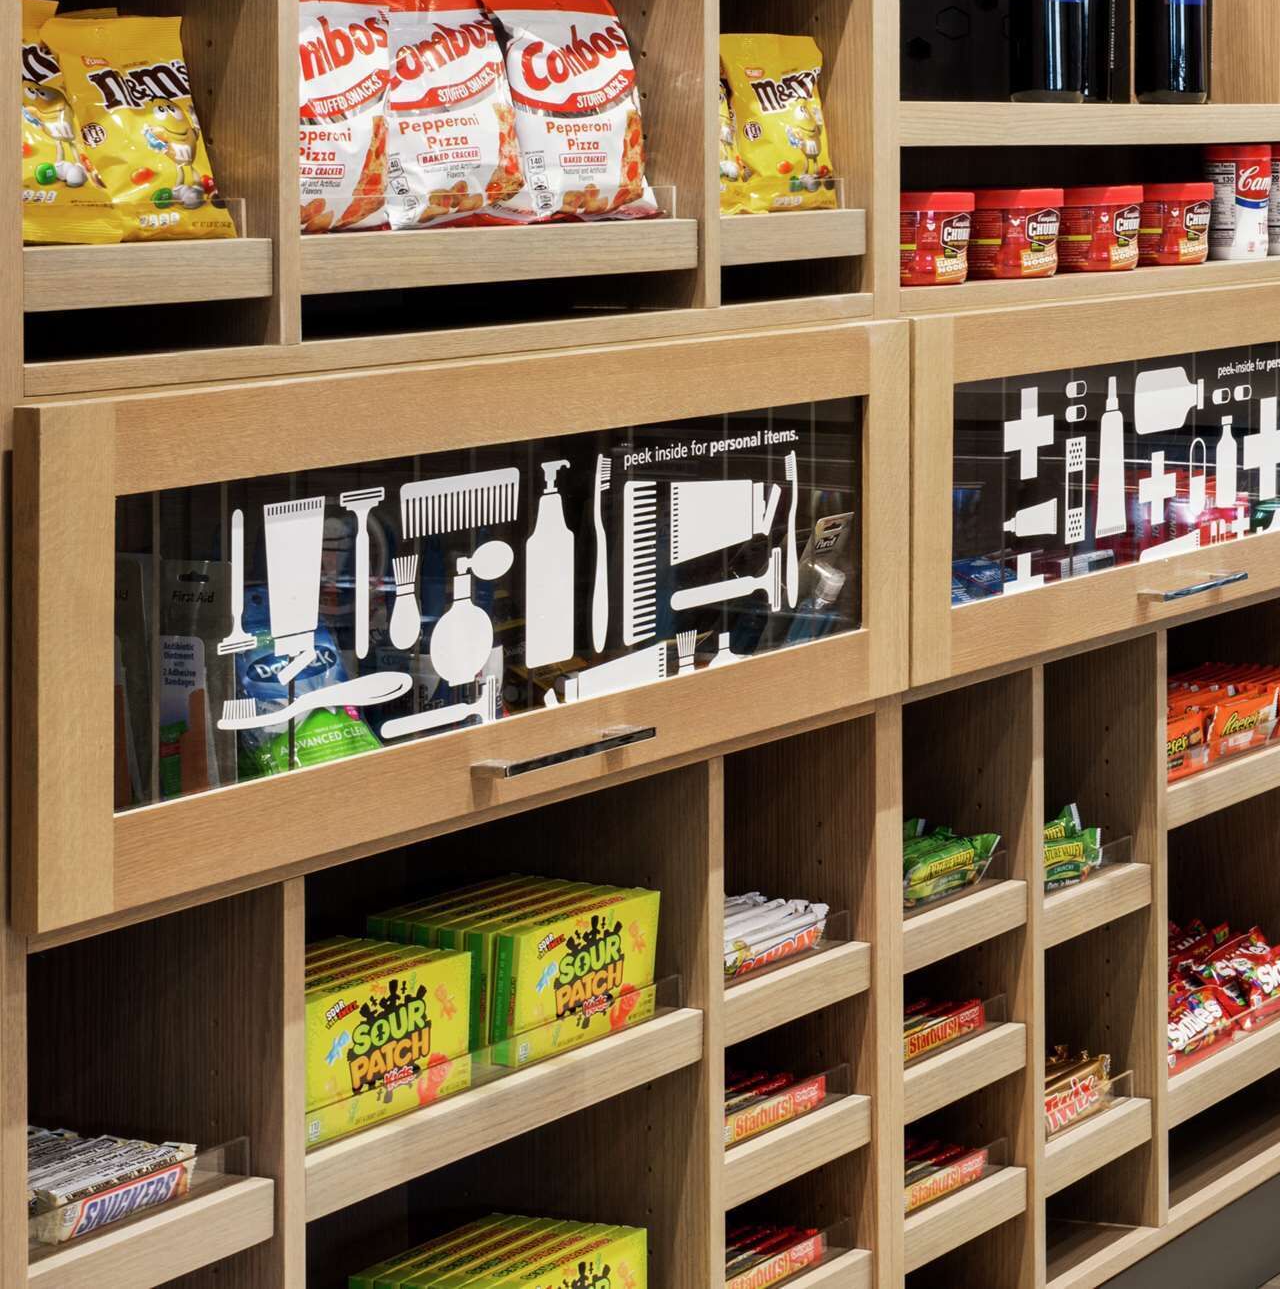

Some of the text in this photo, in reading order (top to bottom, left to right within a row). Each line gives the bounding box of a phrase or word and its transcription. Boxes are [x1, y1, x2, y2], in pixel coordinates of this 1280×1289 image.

[300, 16, 388, 81] mbos
[396, 18, 497, 81] ombos
[521, 24, 629, 92] Combos
[347, 75, 383, 108] SNACKS
[399, 113, 480, 135] Pepperoni
[546, 120, 612, 137] Pepperoni
[427, 133, 469, 150] Pizza
[567, 138, 599, 151] Pizza
[421, 150, 480, 165] BAKED CRACKER
[584, 154, 606, 165] CRACKER
[1217, 363, 1234, 378] peek
[1235, 359, 1254, 372] inside
[1256, 358, 1266, 370] for
[624, 430, 799, 470] peek inside for personal items.
[172, 590, 215, 603] First Aid
[164, 677, 196, 688] Bandages
[168, 668, 196, 678] Adhesive
[559, 935, 621, 984] SOUR
[556, 960, 624, 1015] PATCH
[354, 1000, 426, 1055] SOUR
[351, 1027, 430, 1089] PATCH
[75, 1170, 178, 1235] SNICKERS
